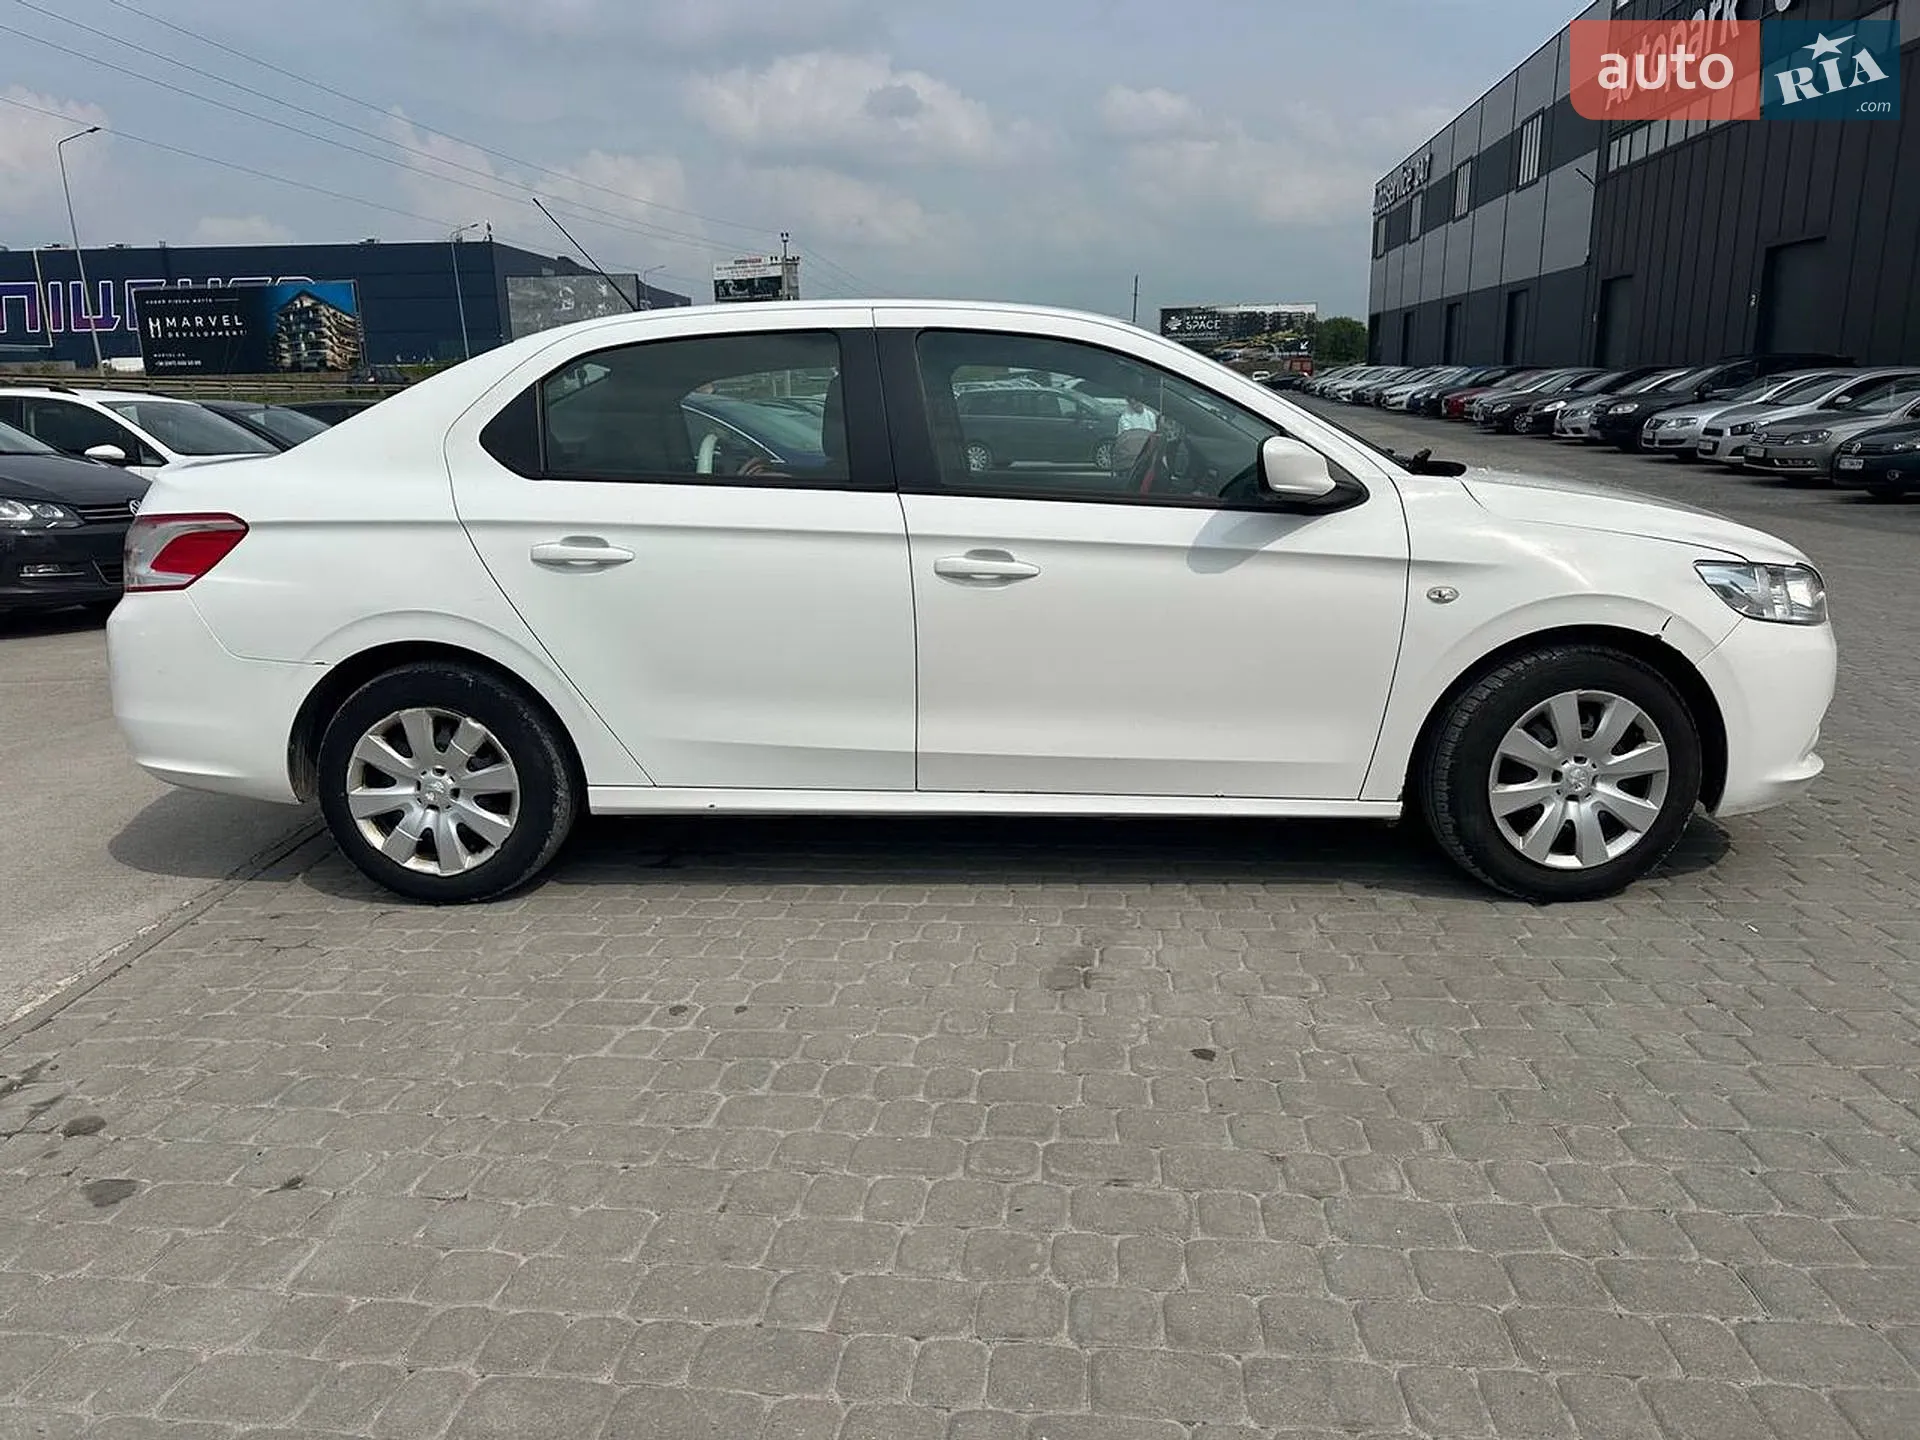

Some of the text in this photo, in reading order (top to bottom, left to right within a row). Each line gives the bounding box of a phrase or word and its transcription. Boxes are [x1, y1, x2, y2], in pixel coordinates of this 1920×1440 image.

[165, 315, 243, 328] MARVEL
[1185, 319, 1221, 330] SPACE
[167, 329, 247, 339] DEVELOPMENT
